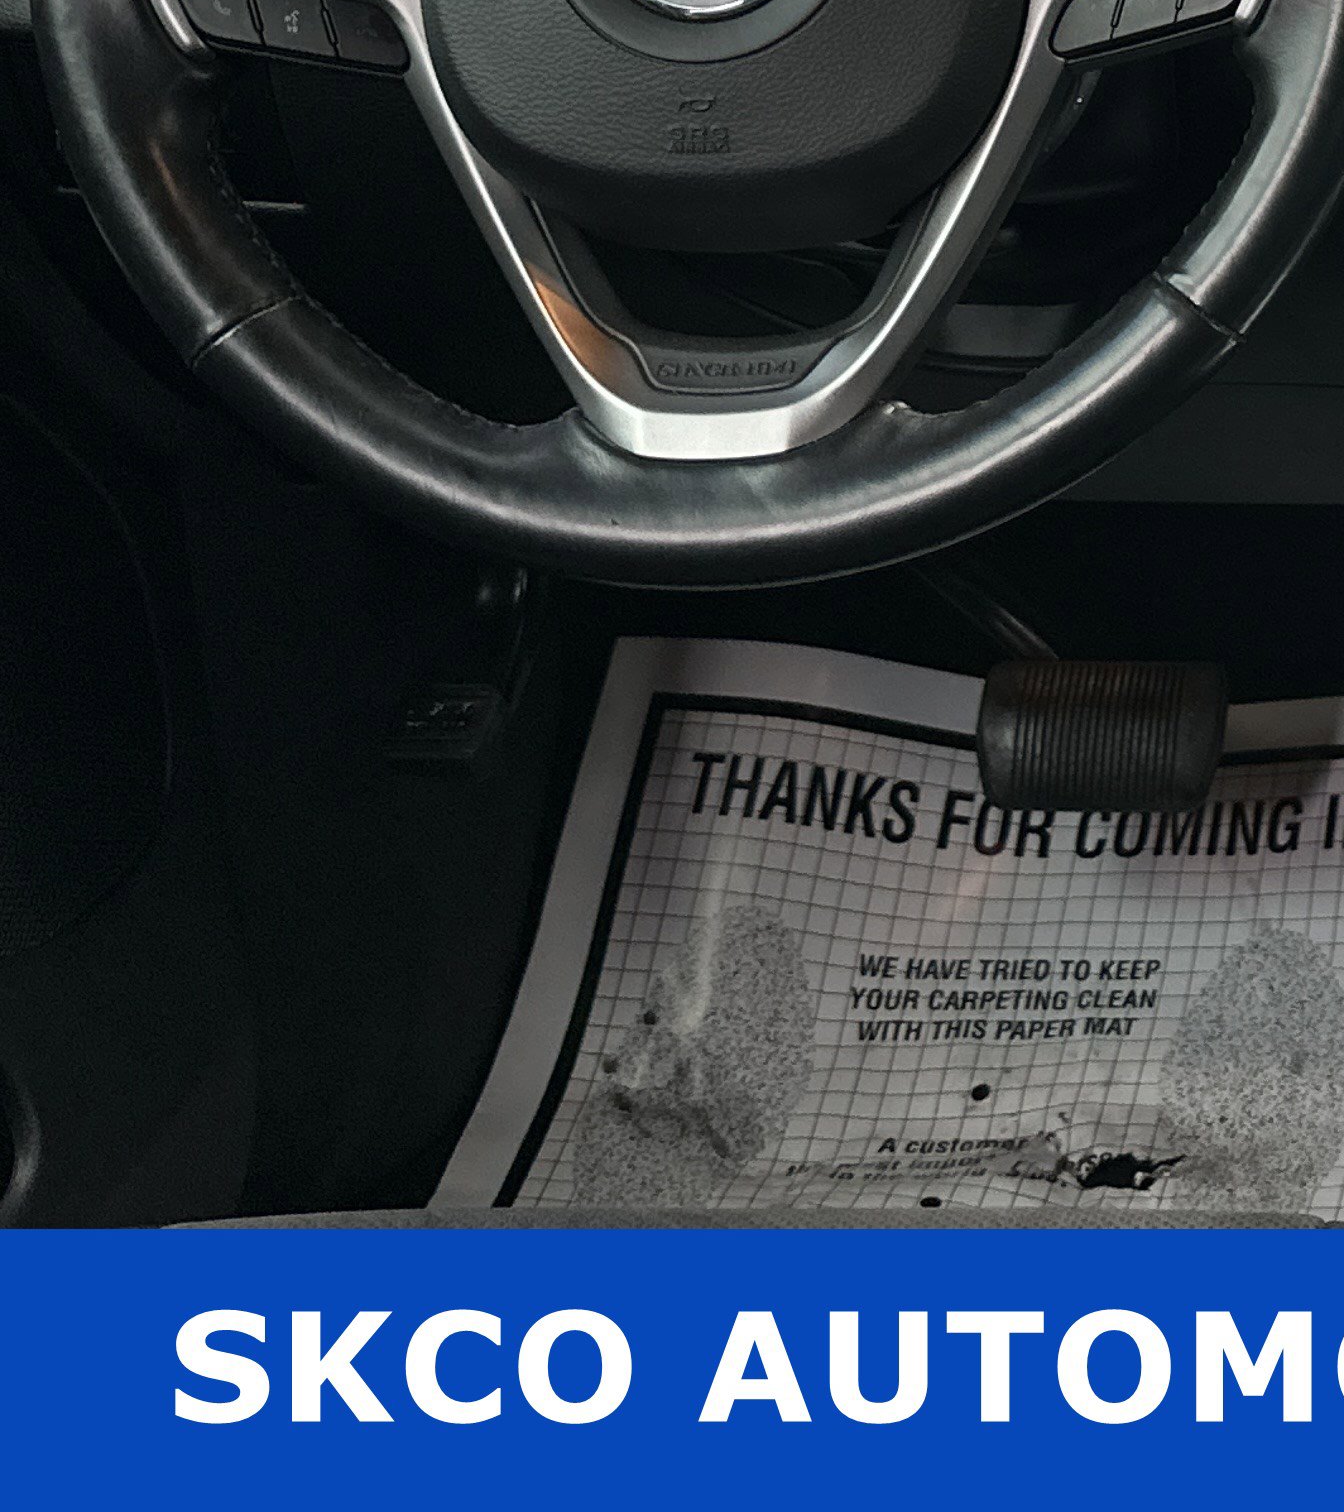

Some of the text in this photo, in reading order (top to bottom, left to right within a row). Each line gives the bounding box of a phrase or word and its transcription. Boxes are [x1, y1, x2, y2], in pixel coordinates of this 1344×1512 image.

[692, 752, 920, 844] THANKS
[936, 790, 1052, 858] FOR
[1074, 794, 1302, 858] COMING
[859, 954, 1161, 981] WE HAVE TRIED TO KEEP
[850, 986, 1157, 1011] YOUR CARPETING CLEAN
[857, 1017, 1139, 1042] WITH THIS PAPER MAT
[877, 1137, 1031, 1155] A customer
